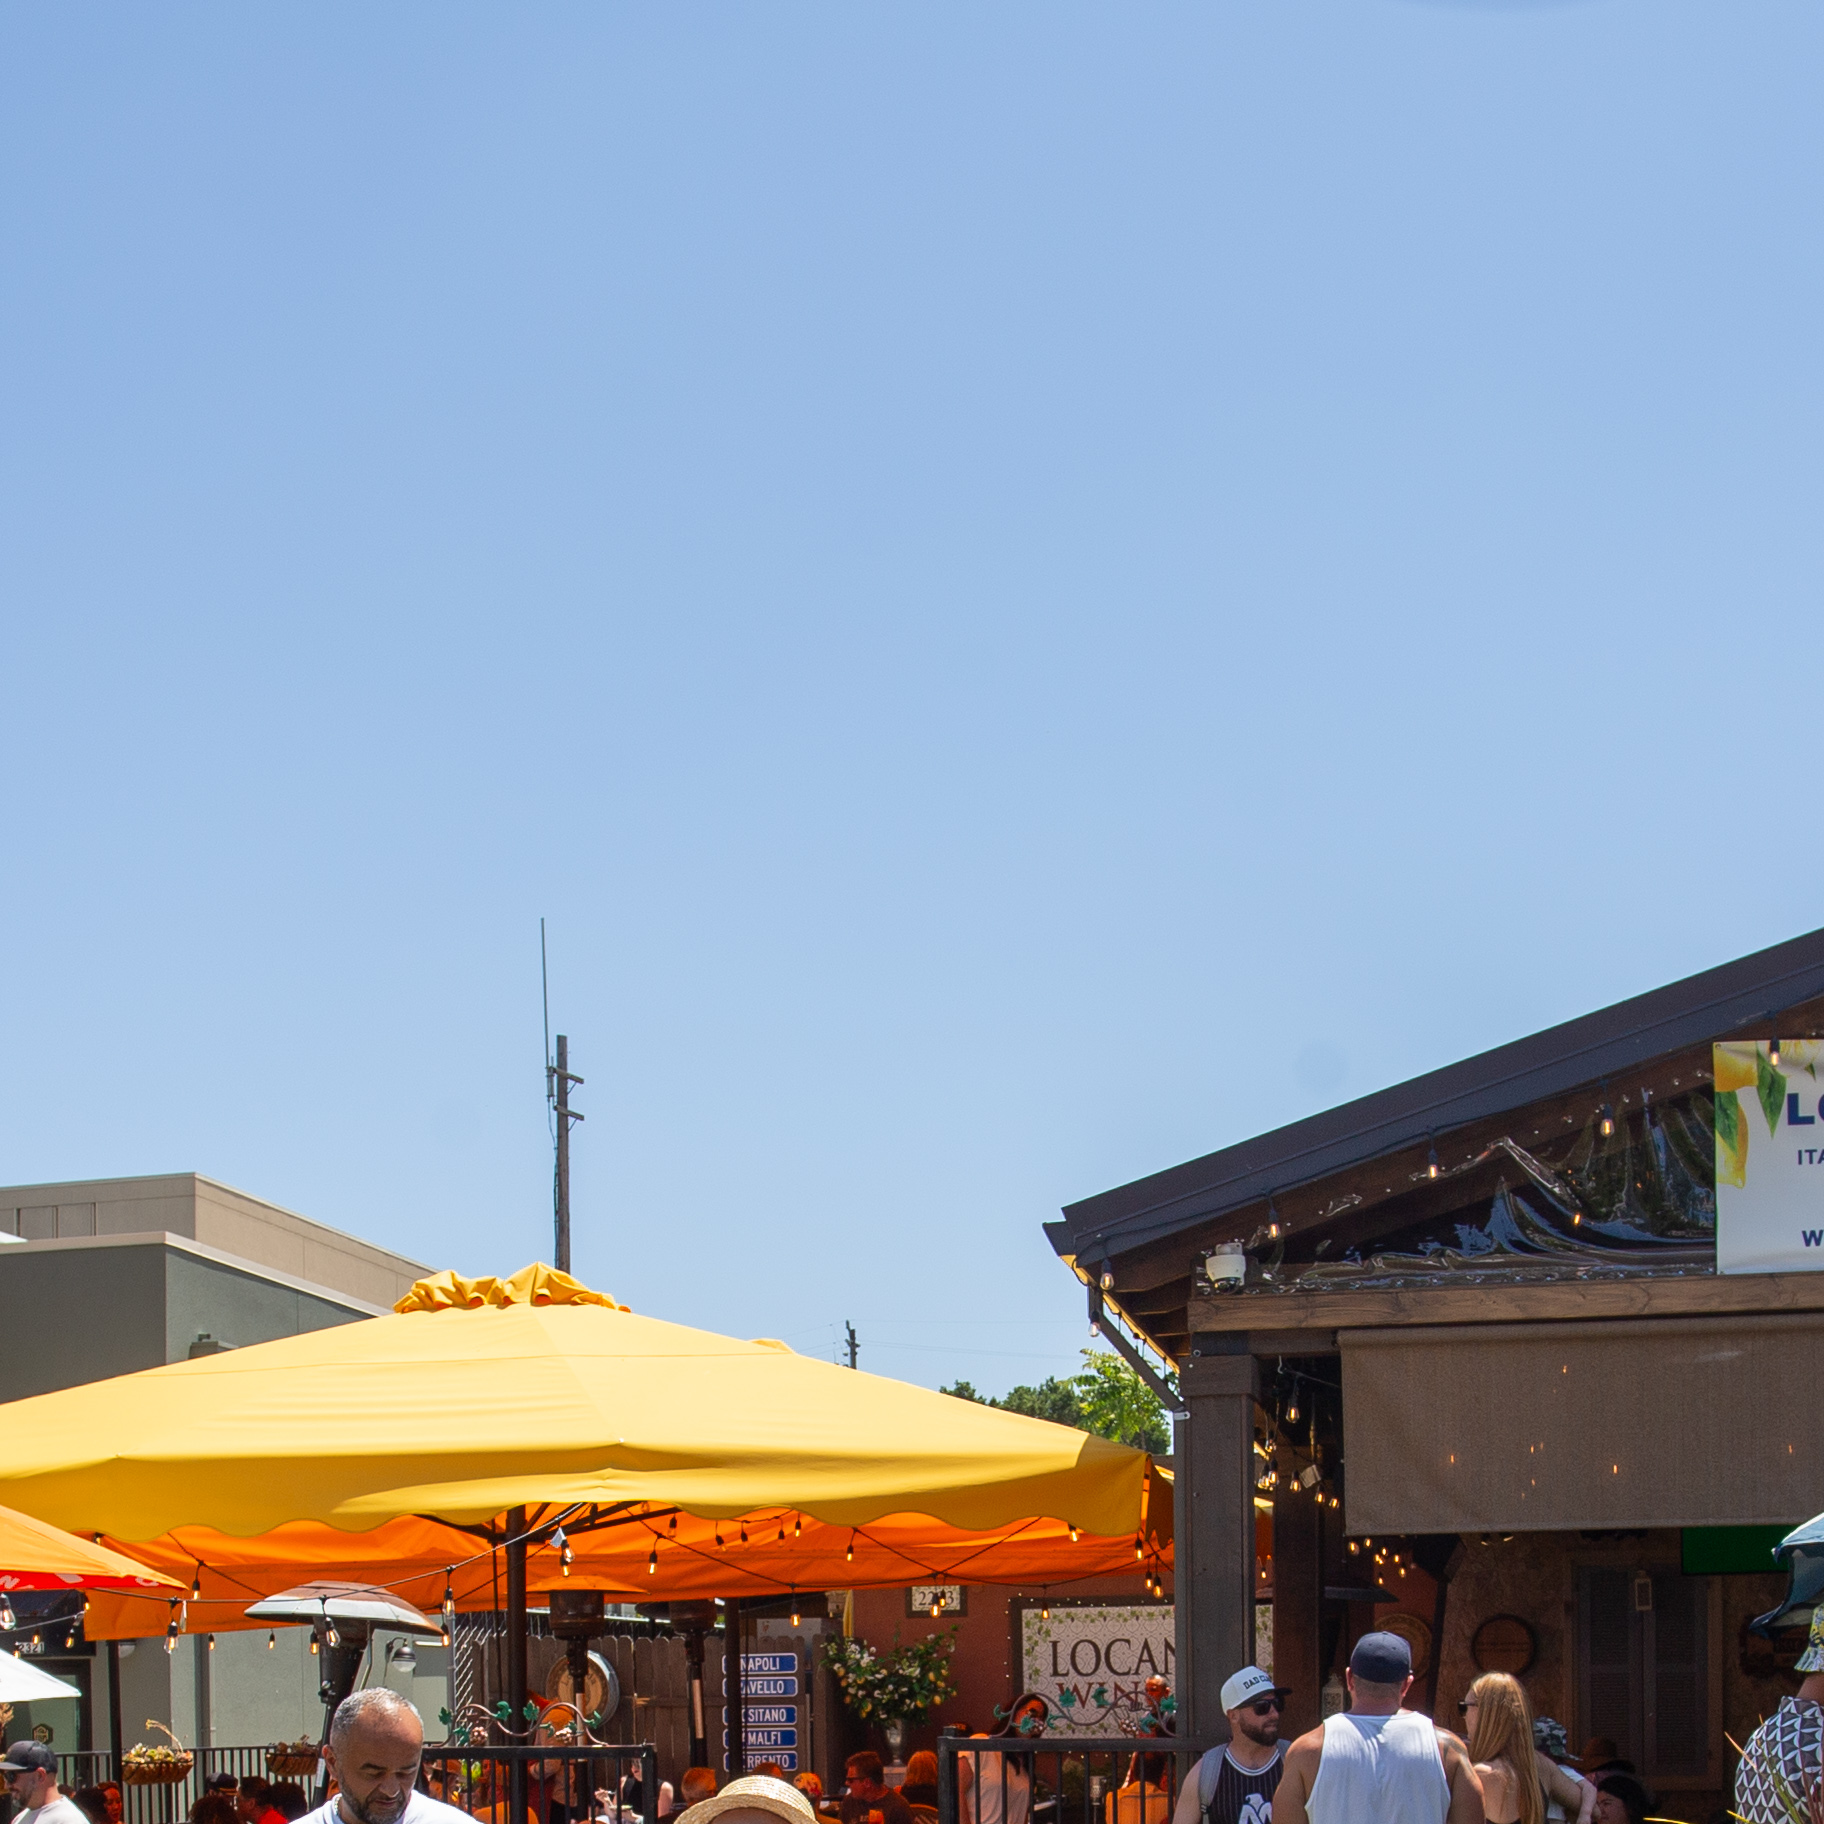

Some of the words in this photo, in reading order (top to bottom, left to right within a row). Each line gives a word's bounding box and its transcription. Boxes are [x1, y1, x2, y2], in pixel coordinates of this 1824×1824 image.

[918, 1591, 954, 1606] 223
[740, 1657, 780, 1671] NAPOLI
[742, 1708, 787, 1722] SITANO
